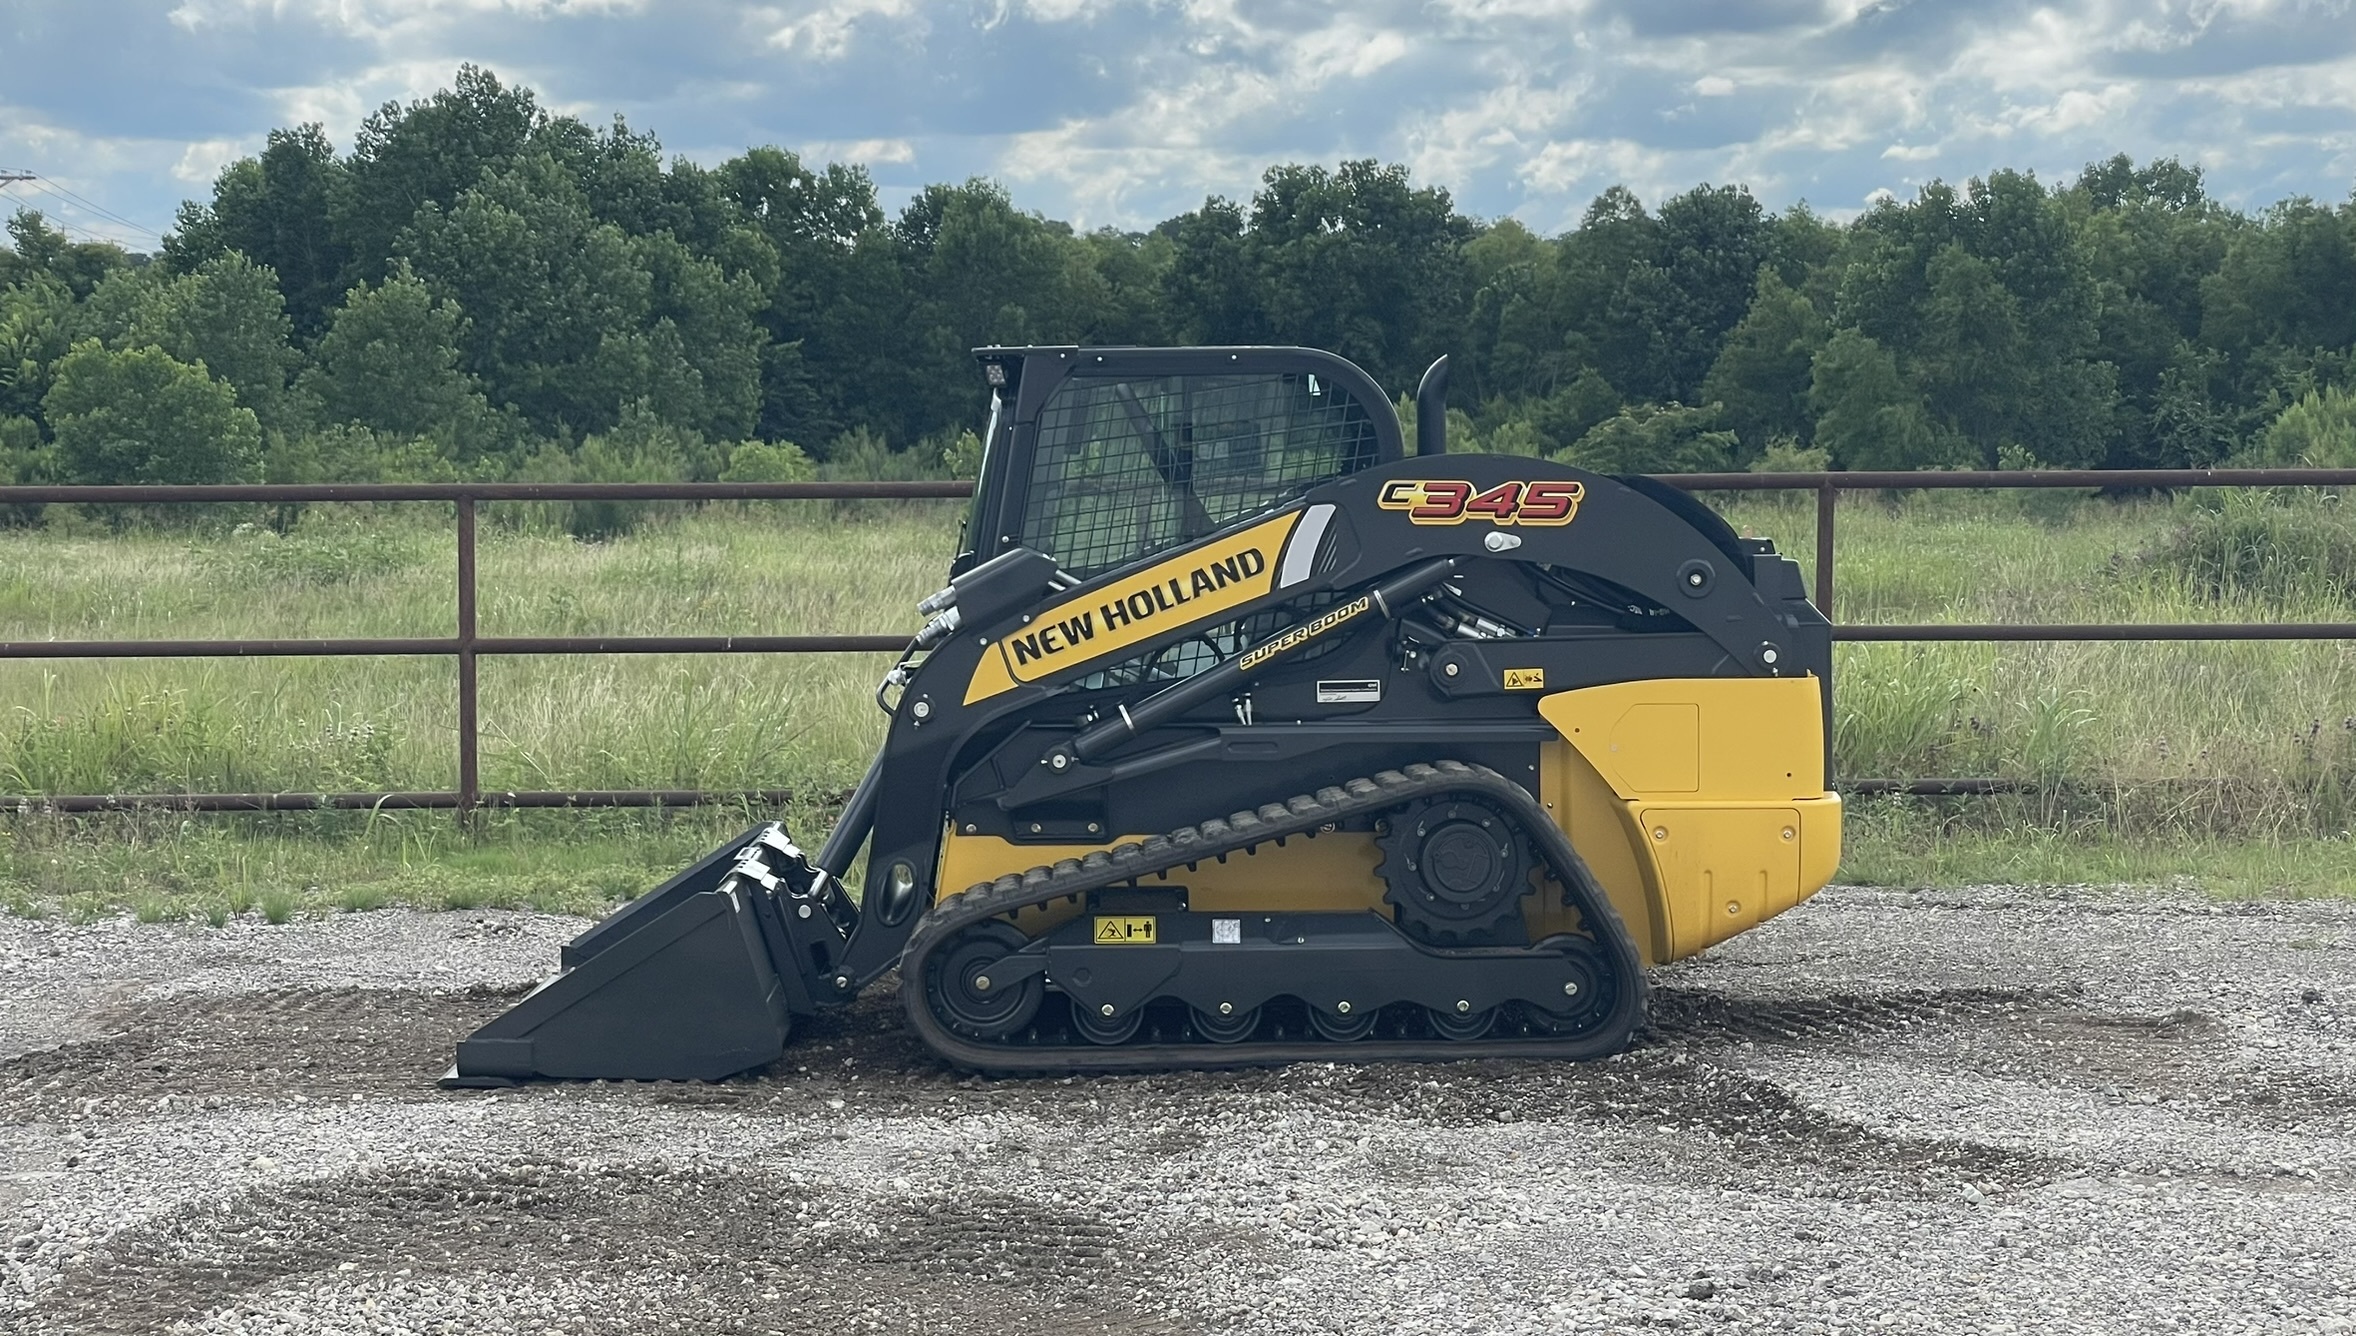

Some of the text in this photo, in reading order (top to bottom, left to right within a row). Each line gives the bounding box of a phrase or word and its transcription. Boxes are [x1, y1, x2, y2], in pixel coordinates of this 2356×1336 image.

[1378, 480, 1585, 524] C345
[1011, 547, 1266, 666] NEW HOLLAND
[1240, 597, 1368, 669] SUPER BOOM
